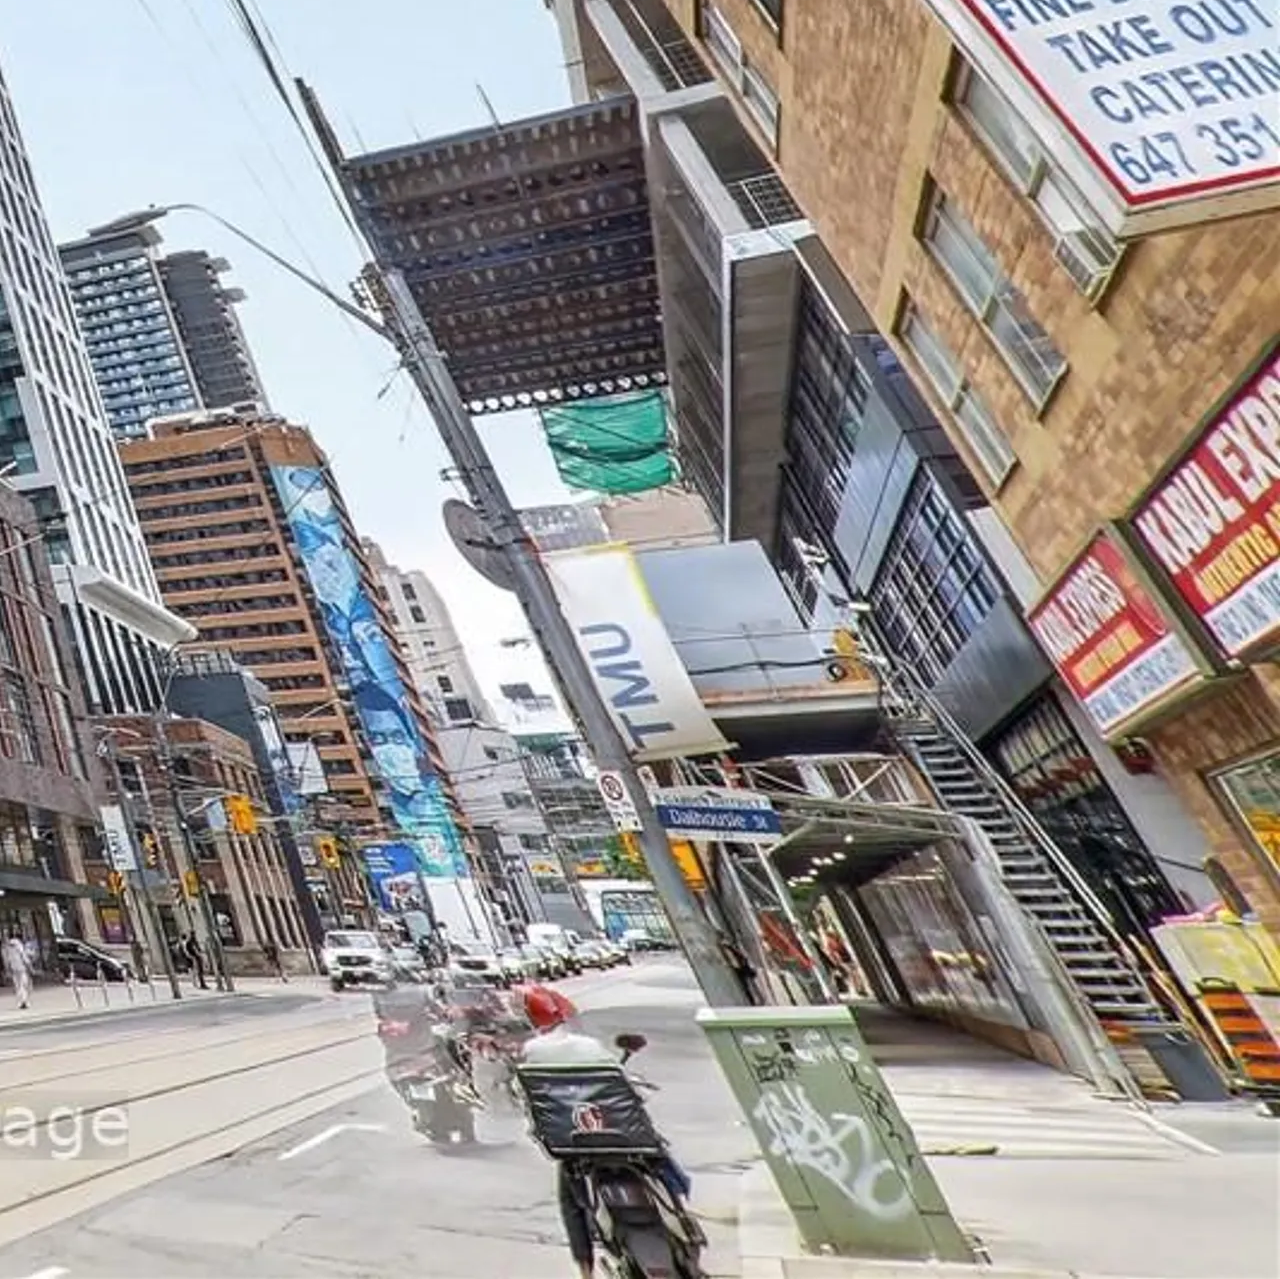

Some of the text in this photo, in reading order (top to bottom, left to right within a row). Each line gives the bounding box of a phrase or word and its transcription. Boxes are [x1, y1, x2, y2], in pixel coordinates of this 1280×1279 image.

[1045, 15, 1174, 73] TAKE
[1090, 46, 1280, 124] CATERIN
[1109, 131, 1197, 184] 647
[1135, 460, 1245, 574] KABUL
[580, 623, 676, 749] TMU
